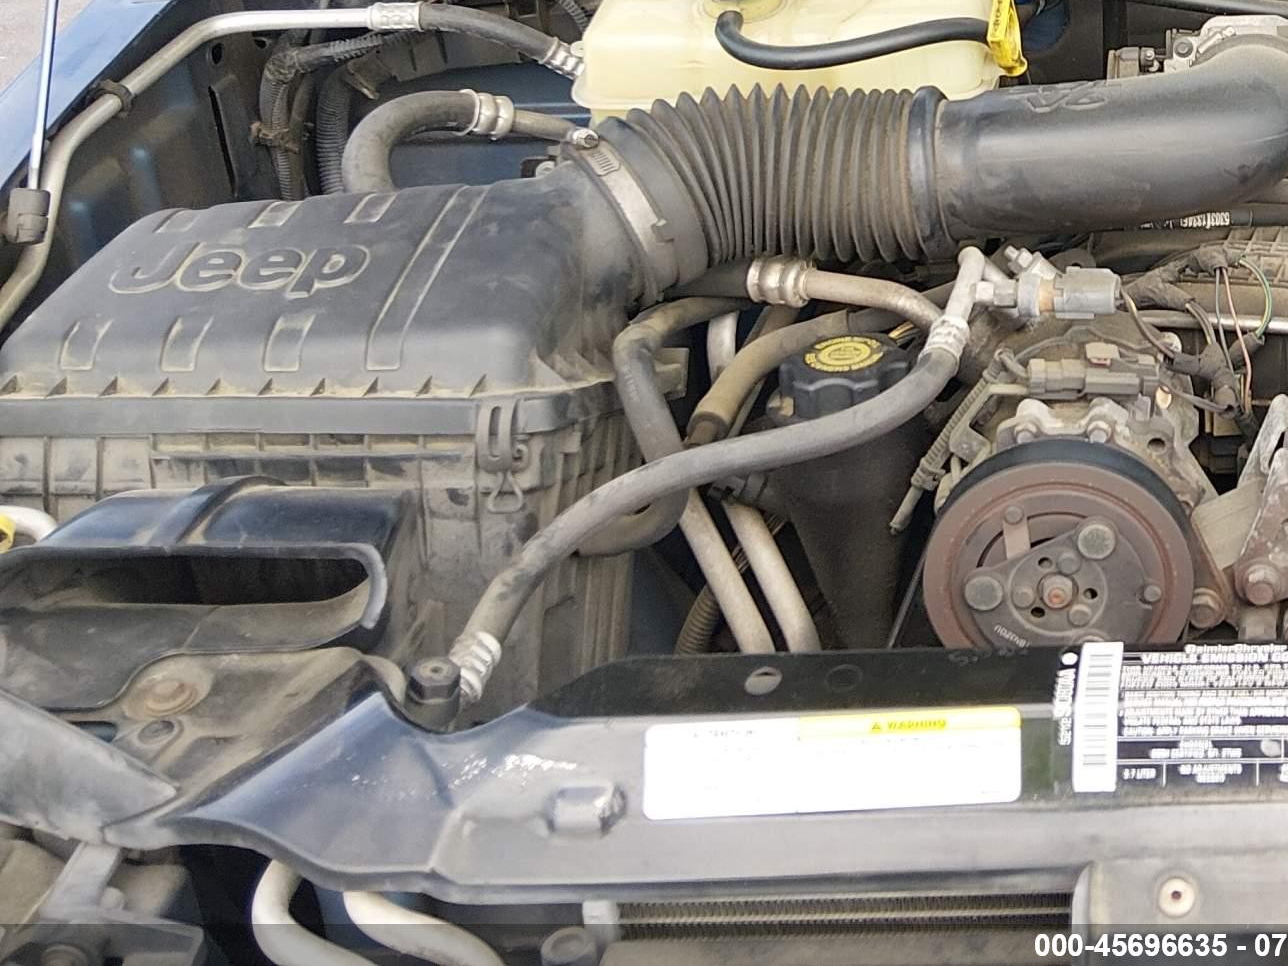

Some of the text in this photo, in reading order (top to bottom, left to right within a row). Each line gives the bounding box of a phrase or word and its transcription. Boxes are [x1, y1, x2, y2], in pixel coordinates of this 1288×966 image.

[107, 242, 371, 299] Jeep
[1142, 653, 1198, 664] VEHICLE
[1200, 652, 1269, 664] EMISSION
